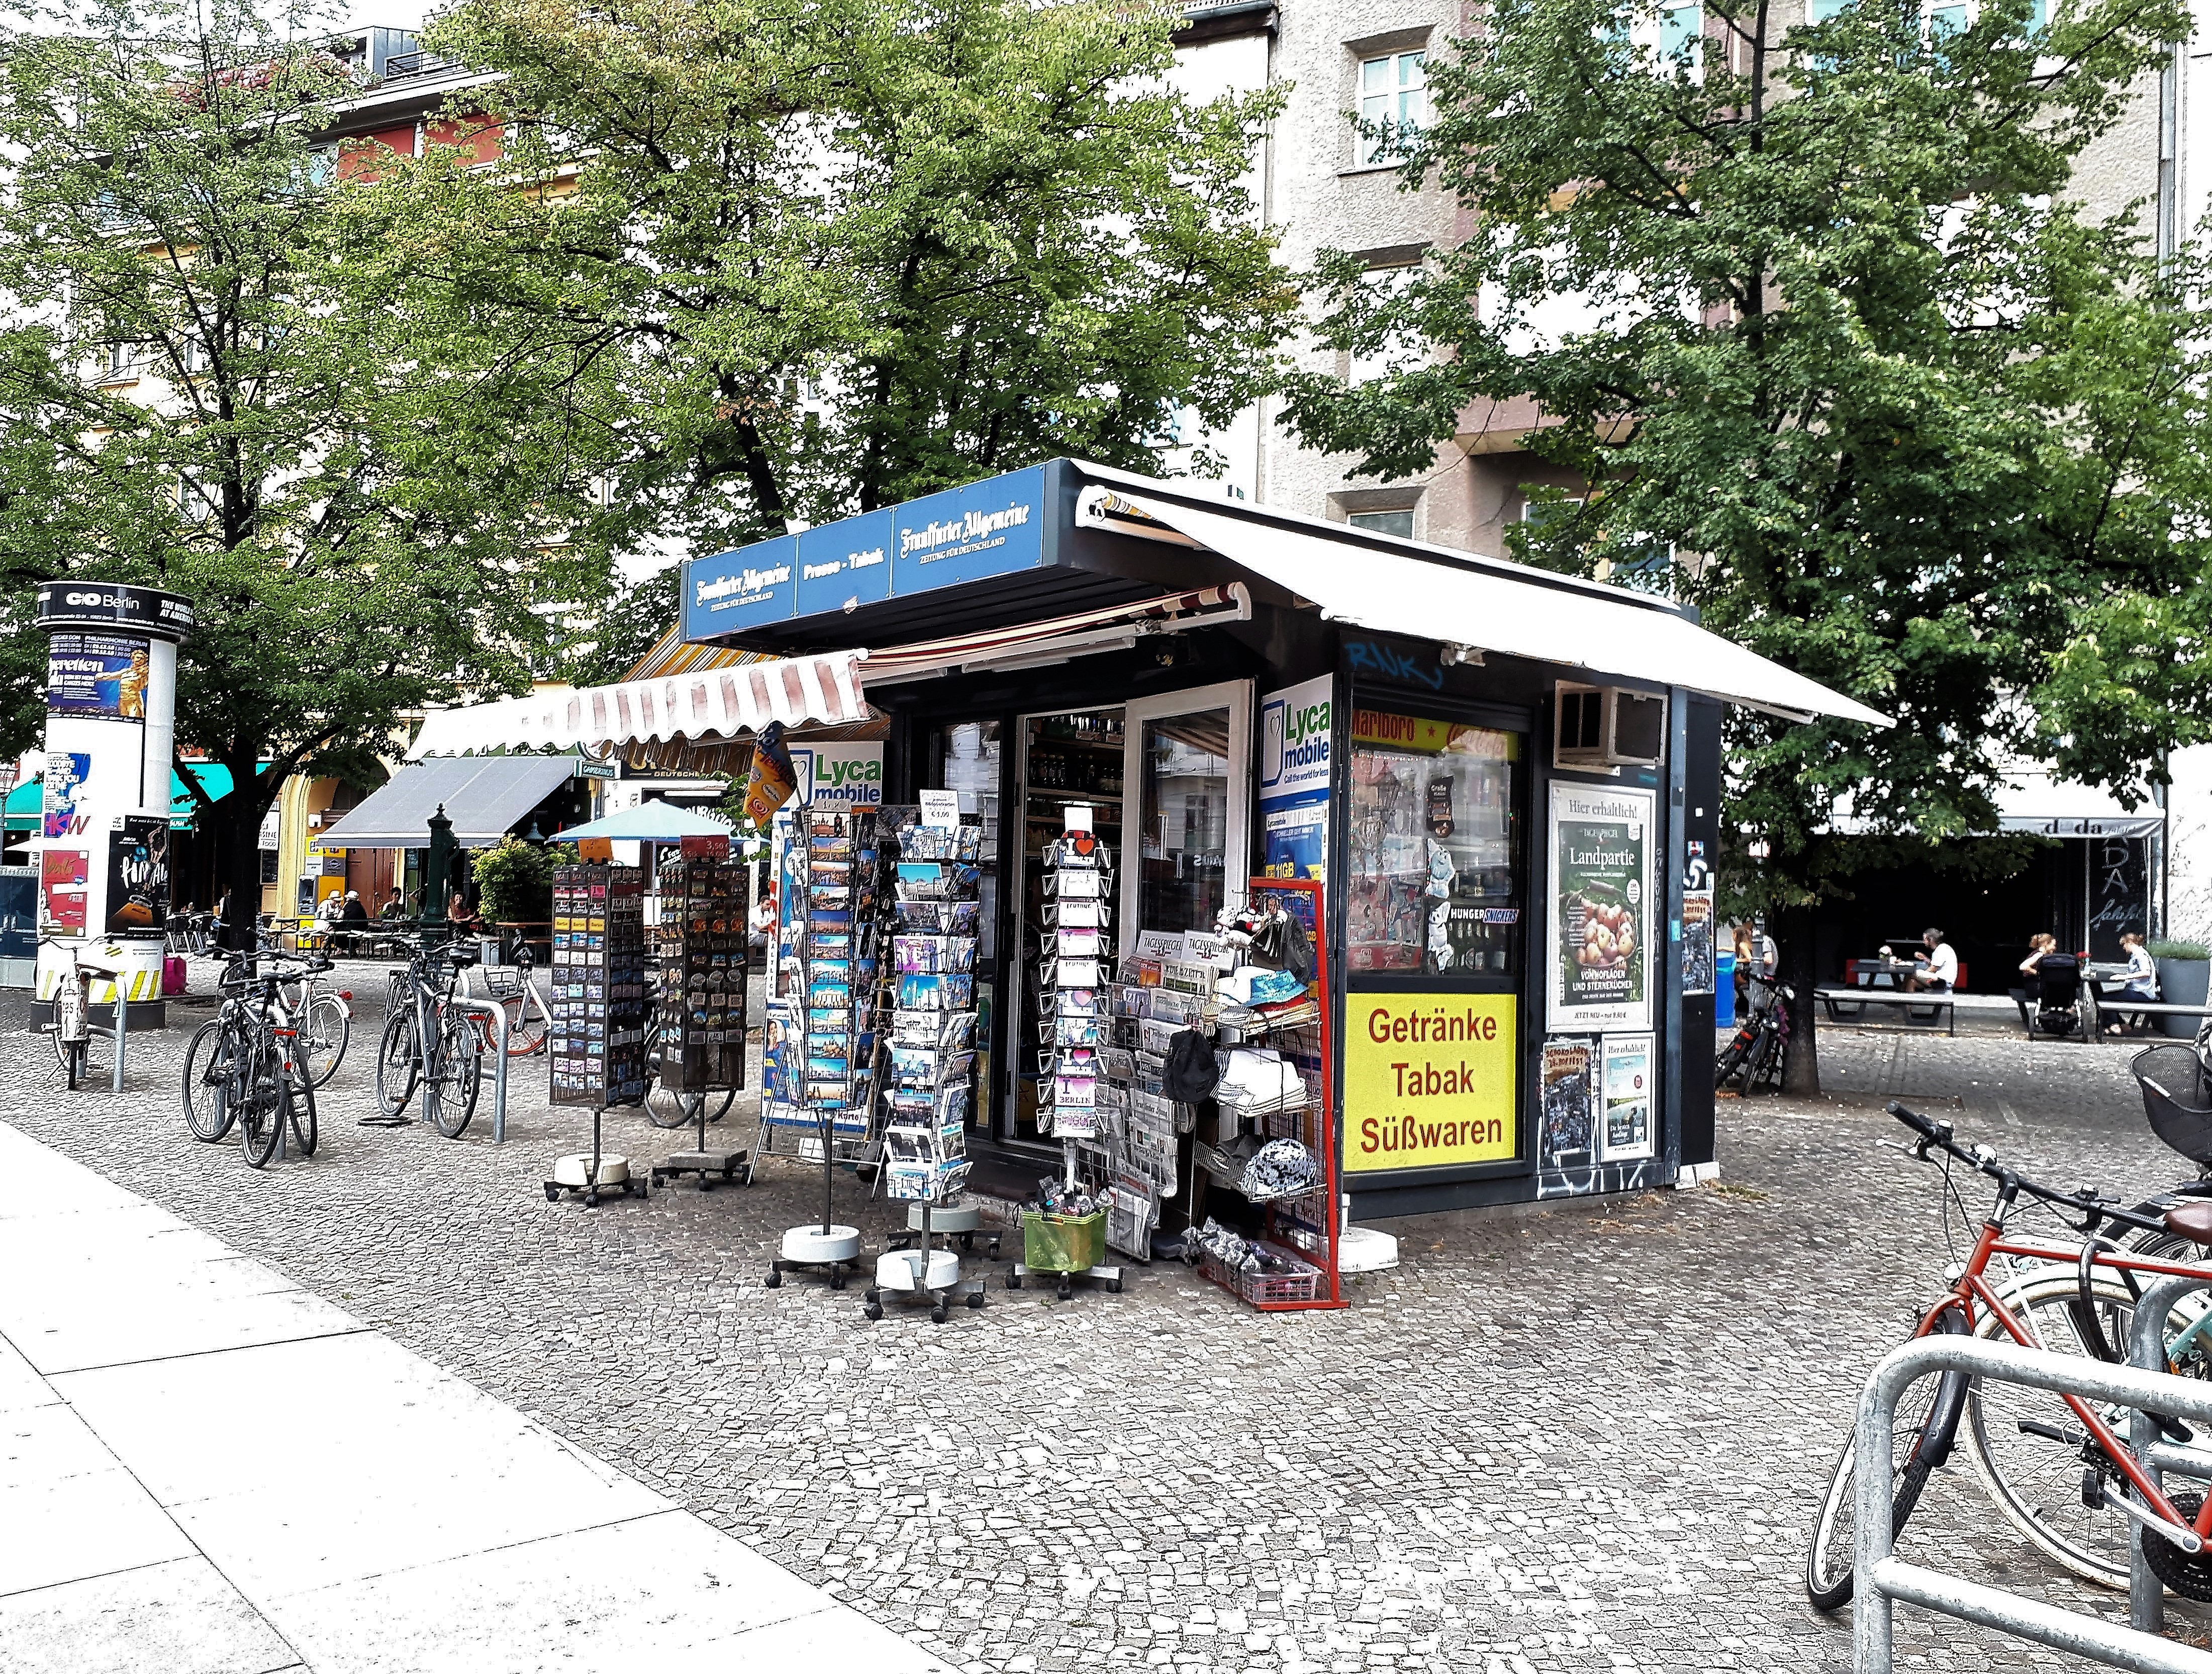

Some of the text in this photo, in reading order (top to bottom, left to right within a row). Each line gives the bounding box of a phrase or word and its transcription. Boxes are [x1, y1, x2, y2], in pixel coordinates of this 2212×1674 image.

[919, 551, 947, 565] ZEITUNG
[959, 536, 1006, 554] DEUTSCHLAND
[103, 595, 140, 610] Berlin
[1286, 702, 1330, 746] Lyca
[1285, 736, 1329, 769] mobile
[815, 754, 881, 786] Lyca
[1284, 774, 1292, 784] Call
[1300, 769, 1312, 781] world
[815, 783, 881, 803] mobile
[1569, 799, 1589, 814] Hier
[1569, 846, 1636, 870] Landpartie
[1451, 908, 1518, 922] HUNGER SNICKERS
[1572, 982, 1586, 992] UND
[1369, 1007, 1497, 1043] Getränke
[1391, 1061, 1475, 1097] Tabak
[1060, 1096, 1091, 1104] BERLIN
[1360, 1115, 1502, 1153] Süßwaren
